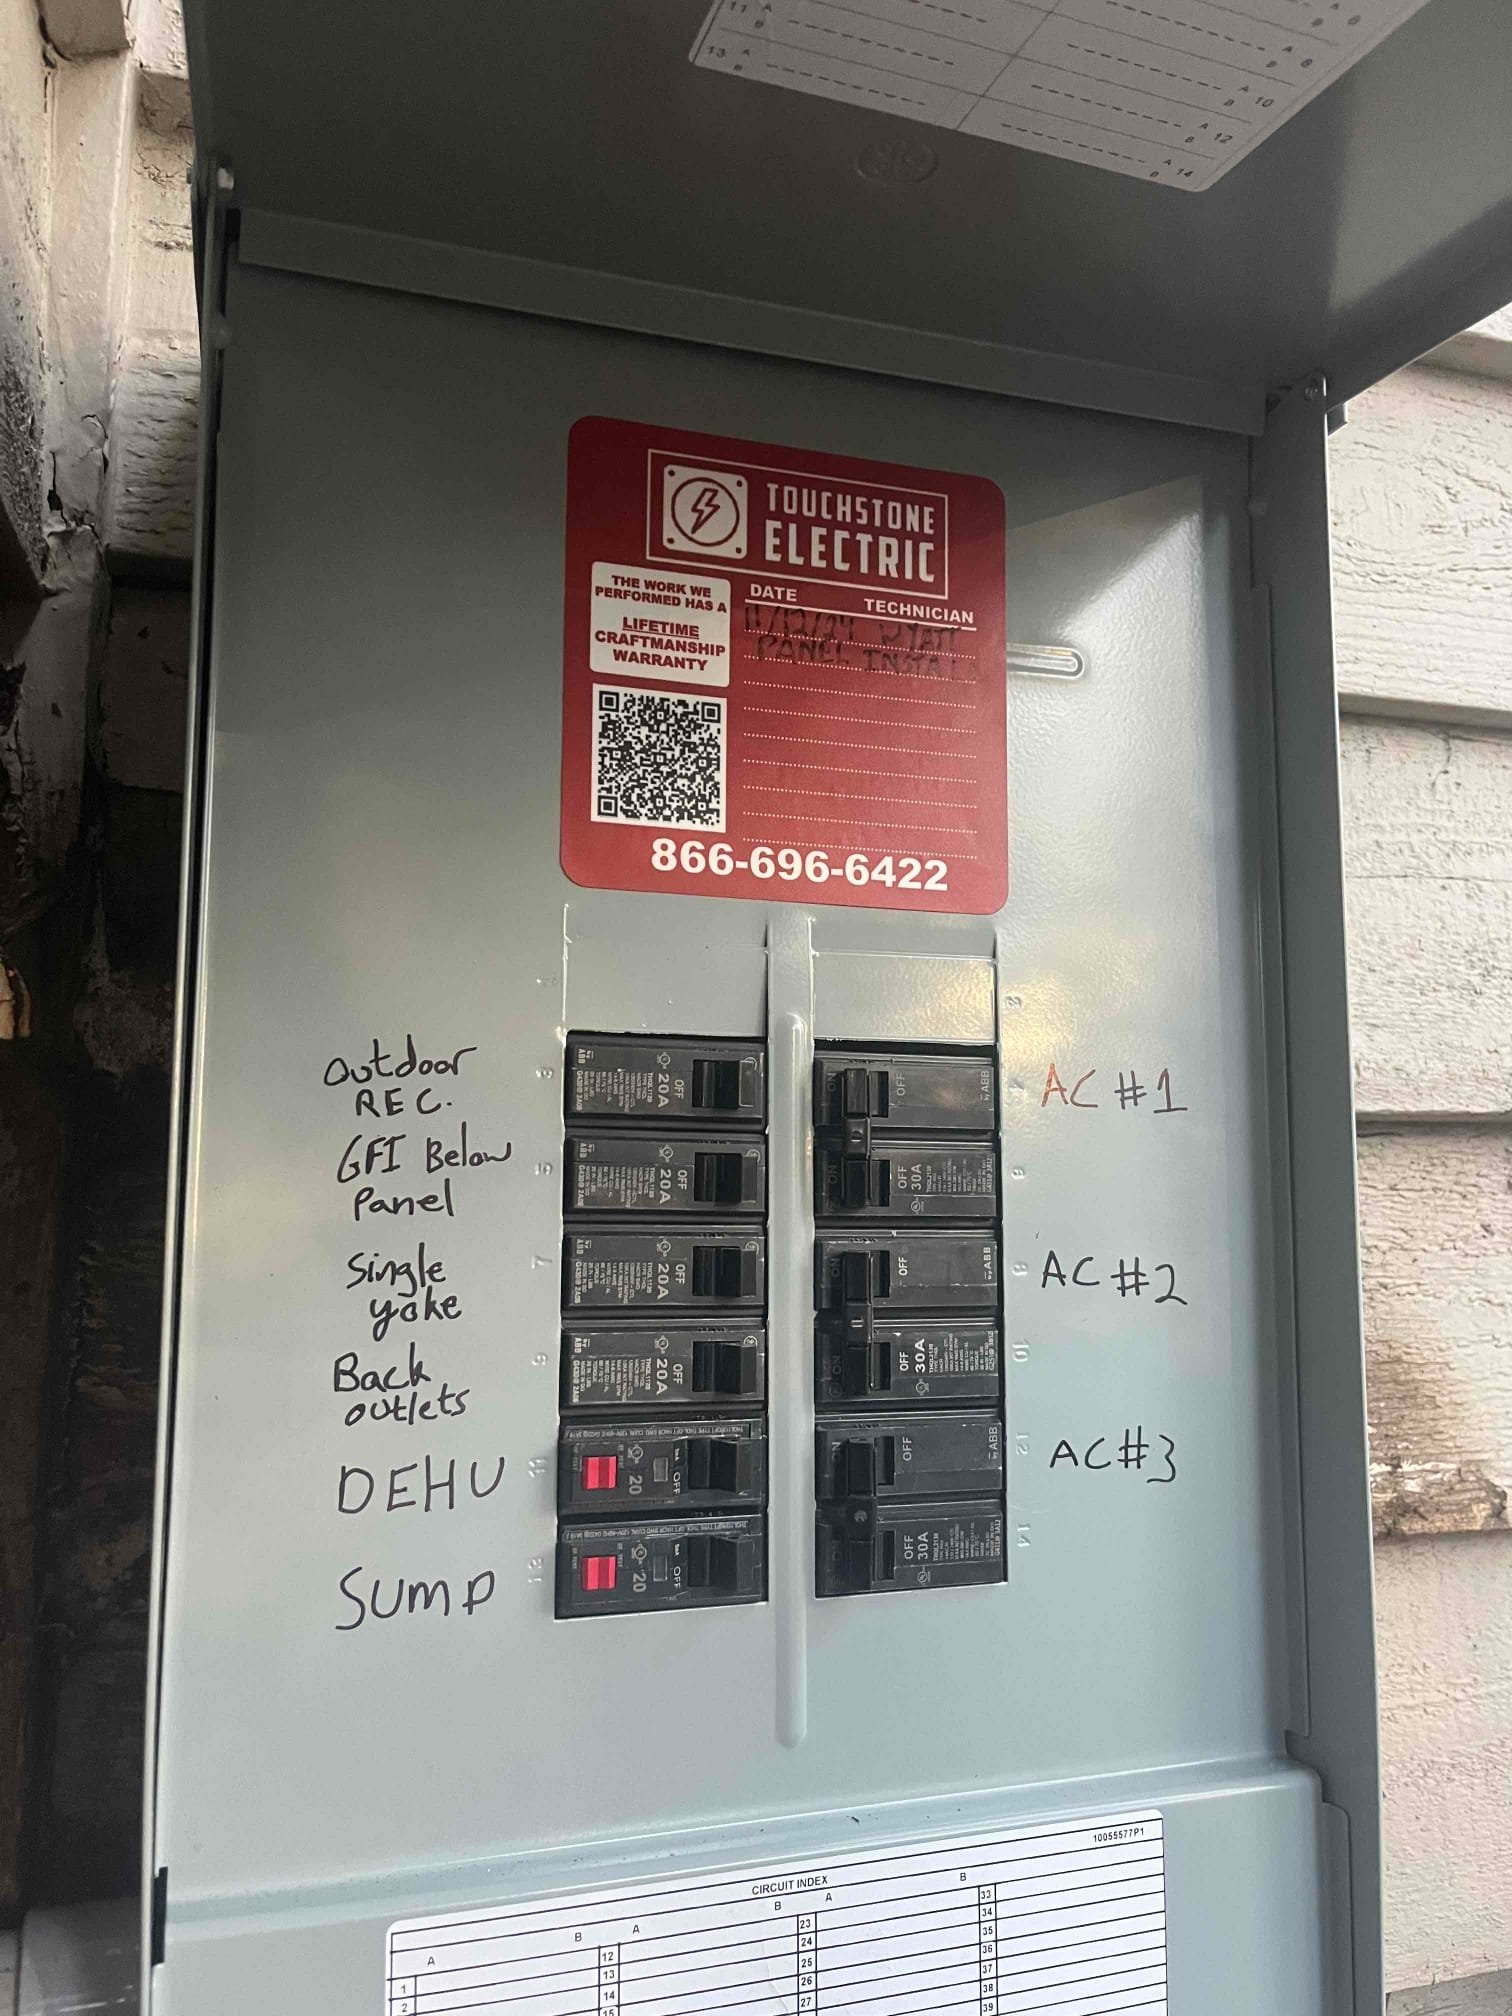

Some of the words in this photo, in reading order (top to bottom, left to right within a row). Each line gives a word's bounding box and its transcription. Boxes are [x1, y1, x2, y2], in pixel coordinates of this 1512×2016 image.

[710, 46, 725, 58] 13
[1256, 96, 1274, 107] 10
[1214, 133, 1232, 143] 12
[1176, 168, 1193, 178] 14
[767, 483, 934, 534] TOUCHSTONE
[765, 520, 934, 582] ELECTRIC
[611, 575, 640, 588] THE
[644, 580, 687, 594] WORK
[690, 586, 711, 597] WE
[750, 584, 797, 601] DATE
[595, 586, 680, 606] PERFORMED
[685, 598, 713, 610] HAS
[717, 603, 726, 613] A
[864, 598, 973, 624] TECHNICIAN
[622, 617, 699, 638] LIFETIME
[595, 630, 725, 656] CRAFTMANSHIP
[757, 635, 849, 664] PANEL
[613, 649, 708, 671] WARRANTY
[651, 838, 948, 891] 866-696-6422
[324, 1034, 477, 1086] Outdoor
[578, 1048, 586, 1064] ABB
[658, 1073, 669, 1107] 20A
[674, 1080, 684, 1099] OFF
[897, 1073, 905, 1096] OFF
[981, 1071, 989, 1094] ABB
[1041, 1063, 1098, 1107] AC
[1114, 1068, 1188, 1114] #1
[356, 1088, 452, 1117] REC.
[337, 1134, 406, 1183] GFI
[427, 1121, 511, 1173] Below
[660, 1168, 671, 1204] 20A
[677, 1170, 687, 1190] OFF
[898, 1165, 907, 1189] OFF
[911, 1164, 921, 1190] 30A
[355, 1178, 454, 1221] Panel
[347, 1242, 446, 1297] Single
[531, 1256, 552, 1269] 7
[899, 1257, 908, 1275] OFF
[658, 1263, 669, 1299] 20A
[675, 1264, 685, 1284] OFF
[1042, 1250, 1100, 1288] AC
[1111, 1257, 1187, 1305] #2
[370, 1285, 462, 1342] yoke
[574, 1337, 582, 1353] ABB
[915, 1338, 925, 1373] 30A
[1012, 1344, 1030, 1362] 10
[334, 1342, 431, 1392] Back
[900, 1352, 909, 1371] OFF
[656, 1358, 668, 1395] 20A
[673, 1364, 683, 1384] OFF
[345, 1383, 470, 1426] outlets
[903, 1436, 912, 1461] OFF
[989, 1427, 997, 1449] ABB
[1015, 1432, 1029, 1456] 12
[338, 1455, 504, 1514] DEHU
[629, 1475, 642, 1494] 20
[673, 1472, 681, 1494] OFF
[1016, 1522, 1031, 1547] 14
[904, 1535, 913, 1559] OFF
[918, 1532, 928, 1560] 30A
[633, 1573, 646, 1592] 20
[673, 1567, 681, 1589] OFF
[336, 1567, 495, 1630] SUMP
[1093, 1827, 1144, 1843] 10055577P1
[752, 1880, 793, 1896] CIRCUIT
[797, 1875, 828, 1889] INDEX
[981, 1890, 991, 1899] 33
[427, 1956, 435, 1965] A
[575, 1933, 582, 1942] B
[632, 1925, 640, 1934] A
[775, 1901, 781, 1911] B
[826, 1893, 832, 1902] A
[960, 1873, 966, 1881] B
[982, 1907, 992, 1917] 34
[800, 1919, 811, 1929] 23
[983, 1926, 993, 1936] 35
[801, 1937, 812, 1946] 24
[983, 1944, 992, 1953] 36
[602, 1952, 613, 1961] 12
[802, 1958, 812, 1968] 25
[603, 1970, 615, 1979] 13
[983, 1964, 992, 1974] 37
[401, 1985, 406, 1993] 1
[801, 1976, 813, 1986] 26
[983, 1983, 993, 1993] 38
[603, 1991, 615, 2000] 14
[801, 1997, 812, 2007] 27
[402, 2004, 407, 2012] 2
[984, 2003, 993, 2012] 39
